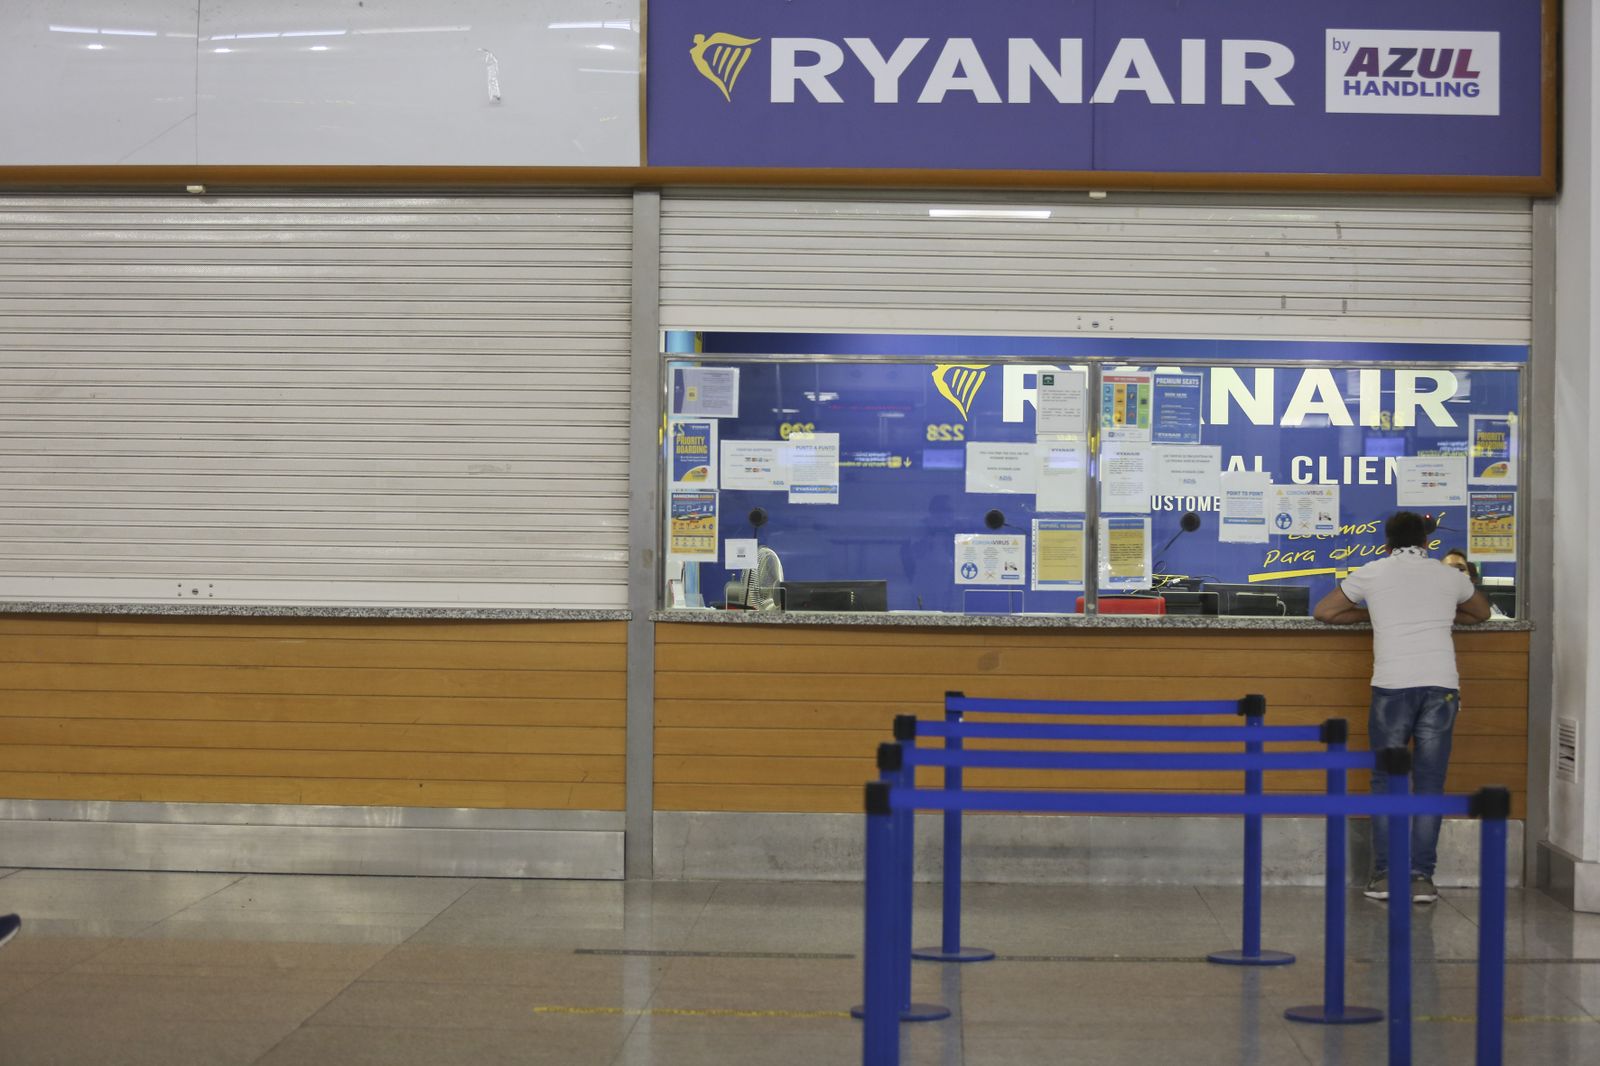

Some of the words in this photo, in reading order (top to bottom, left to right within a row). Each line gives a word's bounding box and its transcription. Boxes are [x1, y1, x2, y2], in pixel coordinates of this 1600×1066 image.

[1332, 37, 1350, 53] by
[769, 37, 1295, 106] RYANAIR
[1344, 47, 1480, 79] AZUL
[1343, 80, 1480, 98] HANDLING
[1002, 365, 1458, 428] RNAIR
[1264, 549, 1316, 568] para
